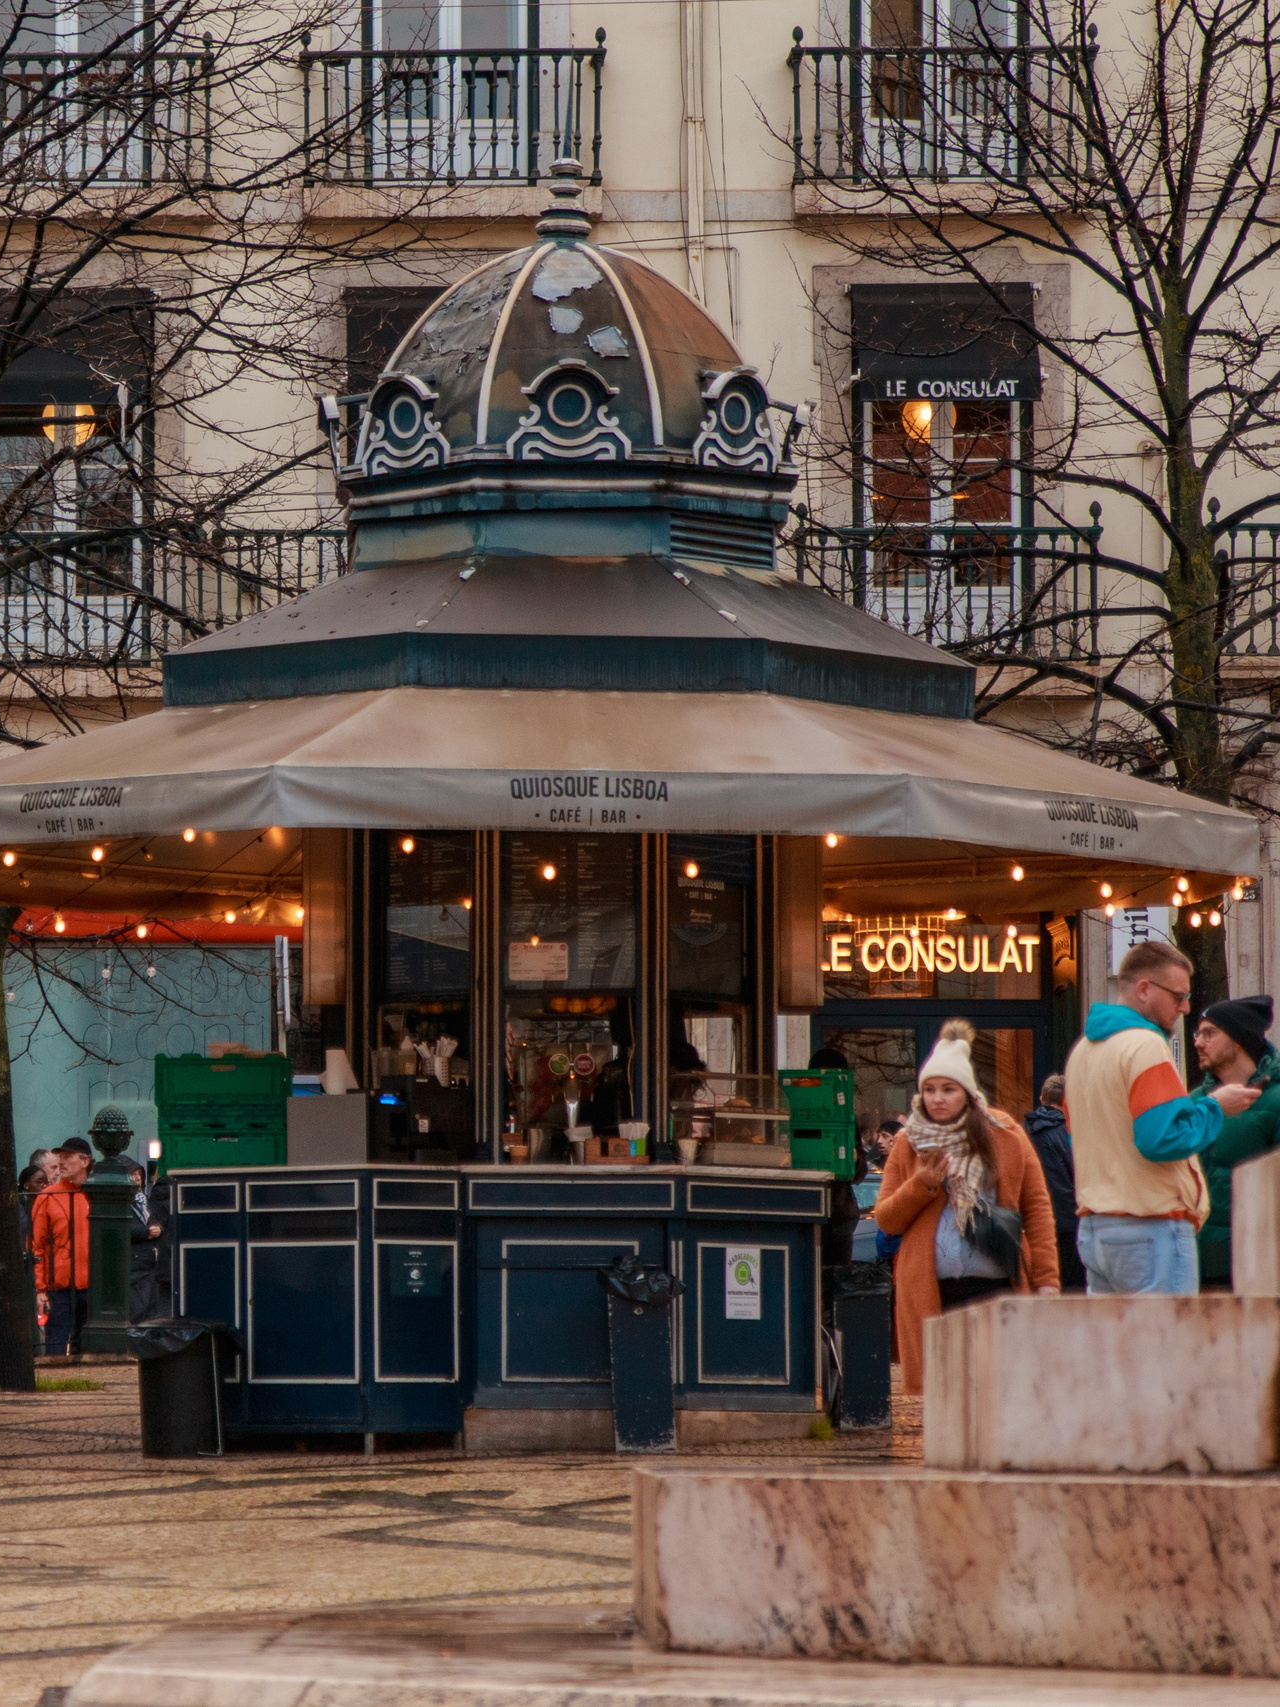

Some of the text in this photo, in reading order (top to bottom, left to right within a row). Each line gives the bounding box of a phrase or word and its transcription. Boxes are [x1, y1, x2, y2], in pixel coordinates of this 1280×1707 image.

[886, 379, 1019, 398] LE CONSULAT
[20, 786, 124, 813] QUIOSQUE LISBOA
[510, 776, 669, 802] QUIOSQUE LISBOA
[45, 817, 95, 833] CAFÉ BAR
[550, 807, 626, 824] CAFÉ BAR
[1044, 800, 1139, 832] QUIOSQUE LISBOA
[1070, 832, 1115, 850] CAFÉ BAR
[821, 933, 1040, 973] E CONSULAT
